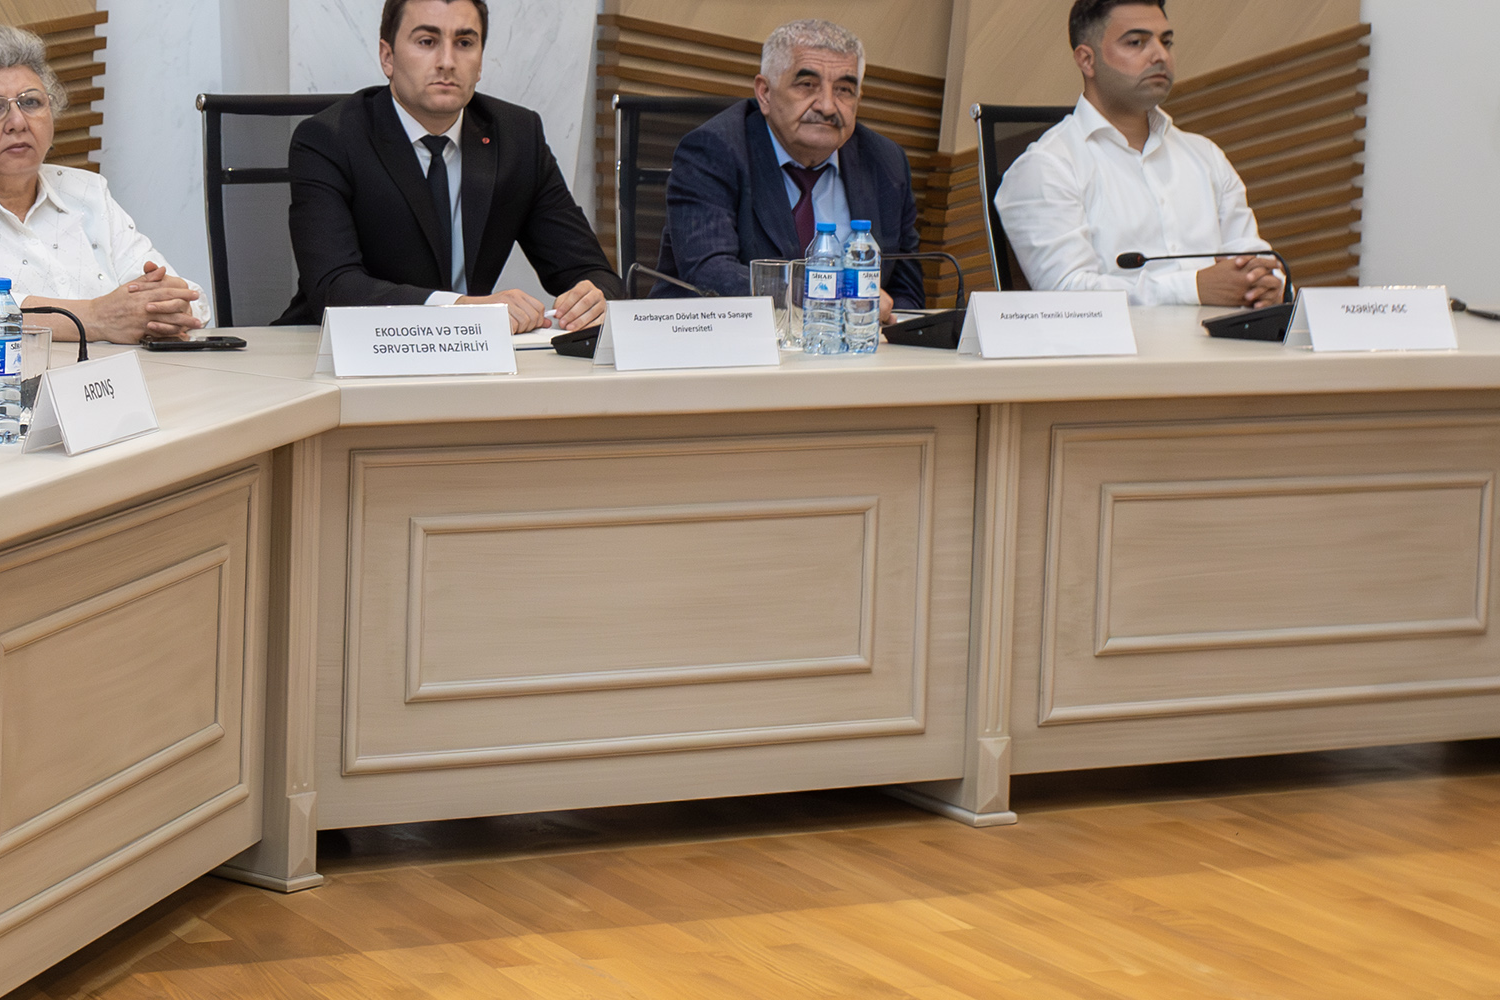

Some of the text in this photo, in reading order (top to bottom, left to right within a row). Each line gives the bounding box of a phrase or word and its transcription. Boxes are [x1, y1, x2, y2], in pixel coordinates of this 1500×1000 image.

[633, 310, 753, 323] Azərbaycan Dövlət Neft və Sənaye
[375, 323, 482, 338] EKOLOGİYA VƏ TƏBİİ
[672, 323, 713, 333] Universiteti
[373, 339, 489, 355] SƏRVƏTLƏR NAZİRLİYİ
[83, 378, 115, 402] ARDNŞ
